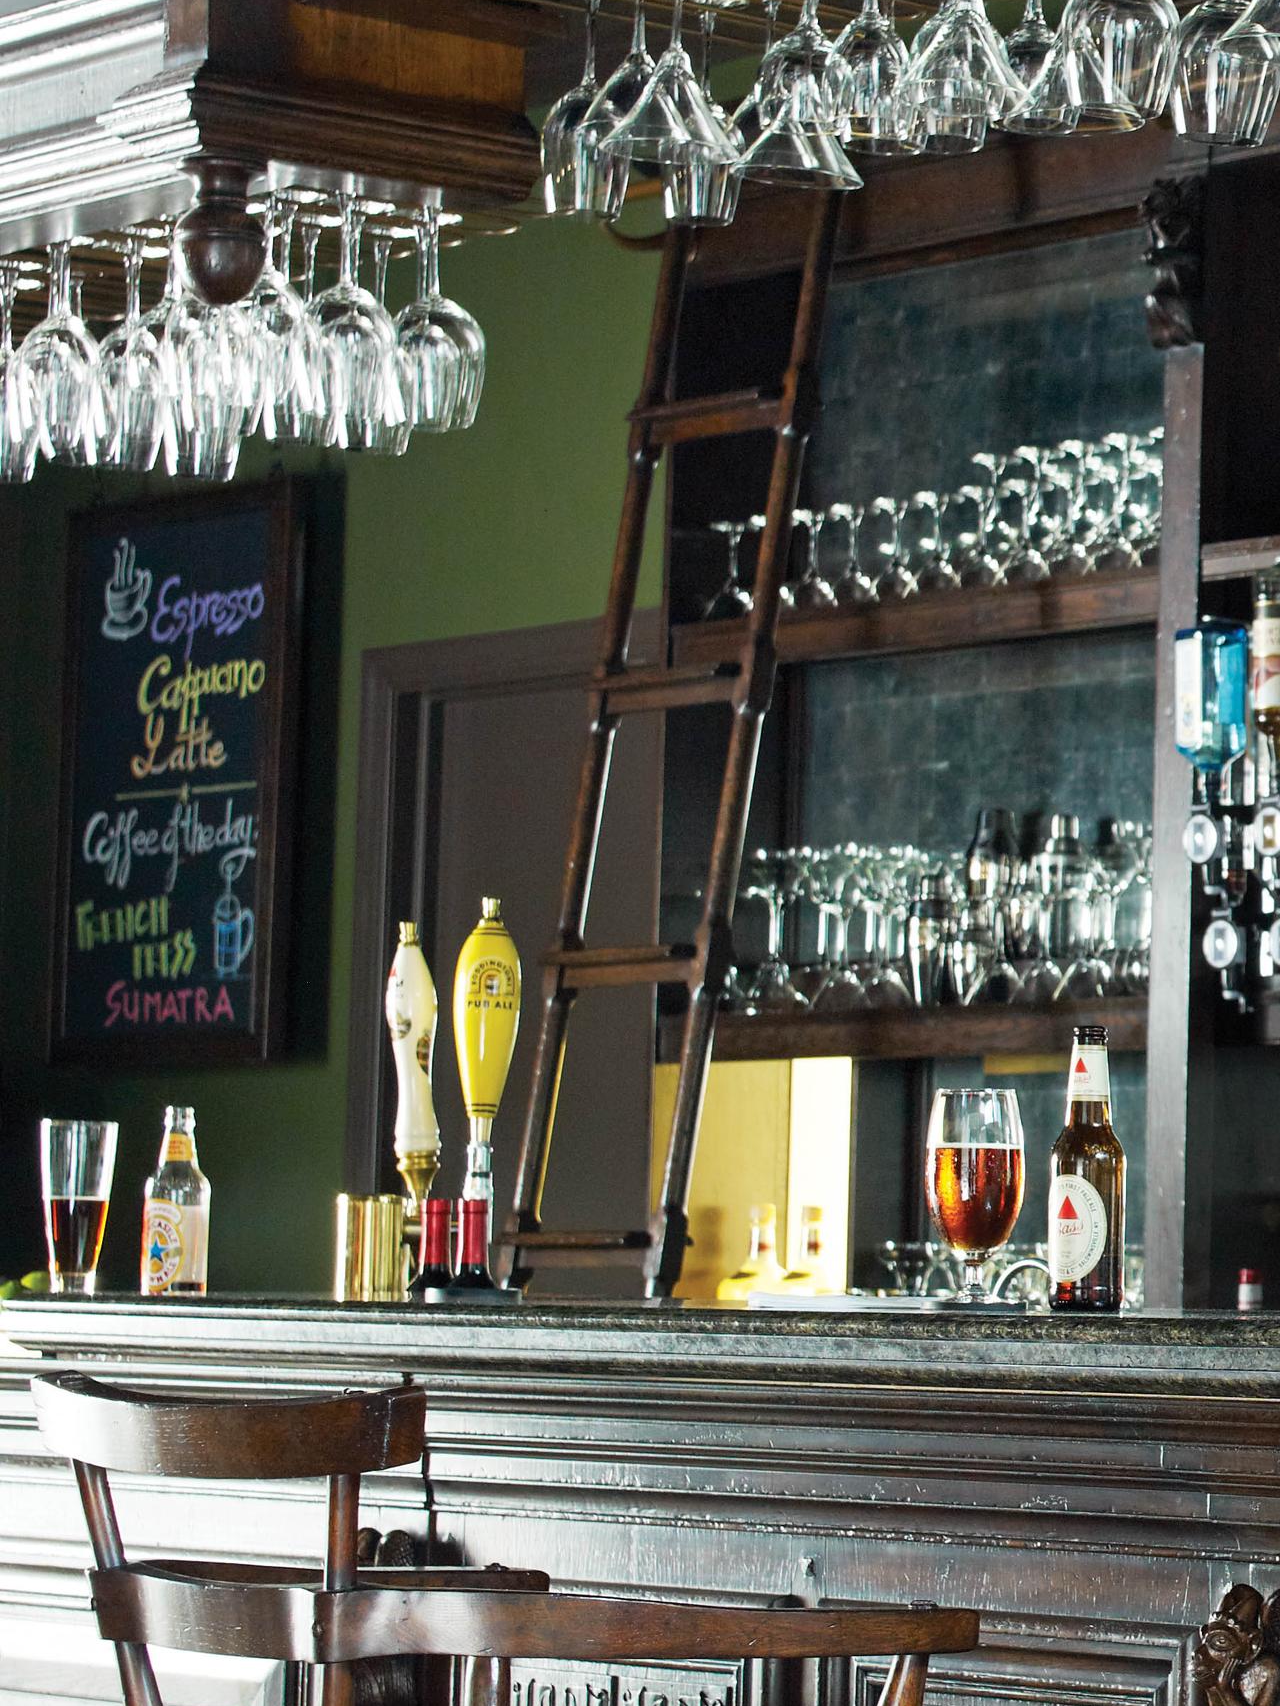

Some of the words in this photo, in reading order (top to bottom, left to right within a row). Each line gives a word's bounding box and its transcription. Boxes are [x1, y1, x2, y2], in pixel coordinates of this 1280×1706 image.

[150, 574, 265, 662] Espresso
[131, 714, 228, 779] Latte
[82, 807, 159, 889] Coffee
[182, 800, 215, 856] the
[105, 979, 236, 1028] SUMATRA
